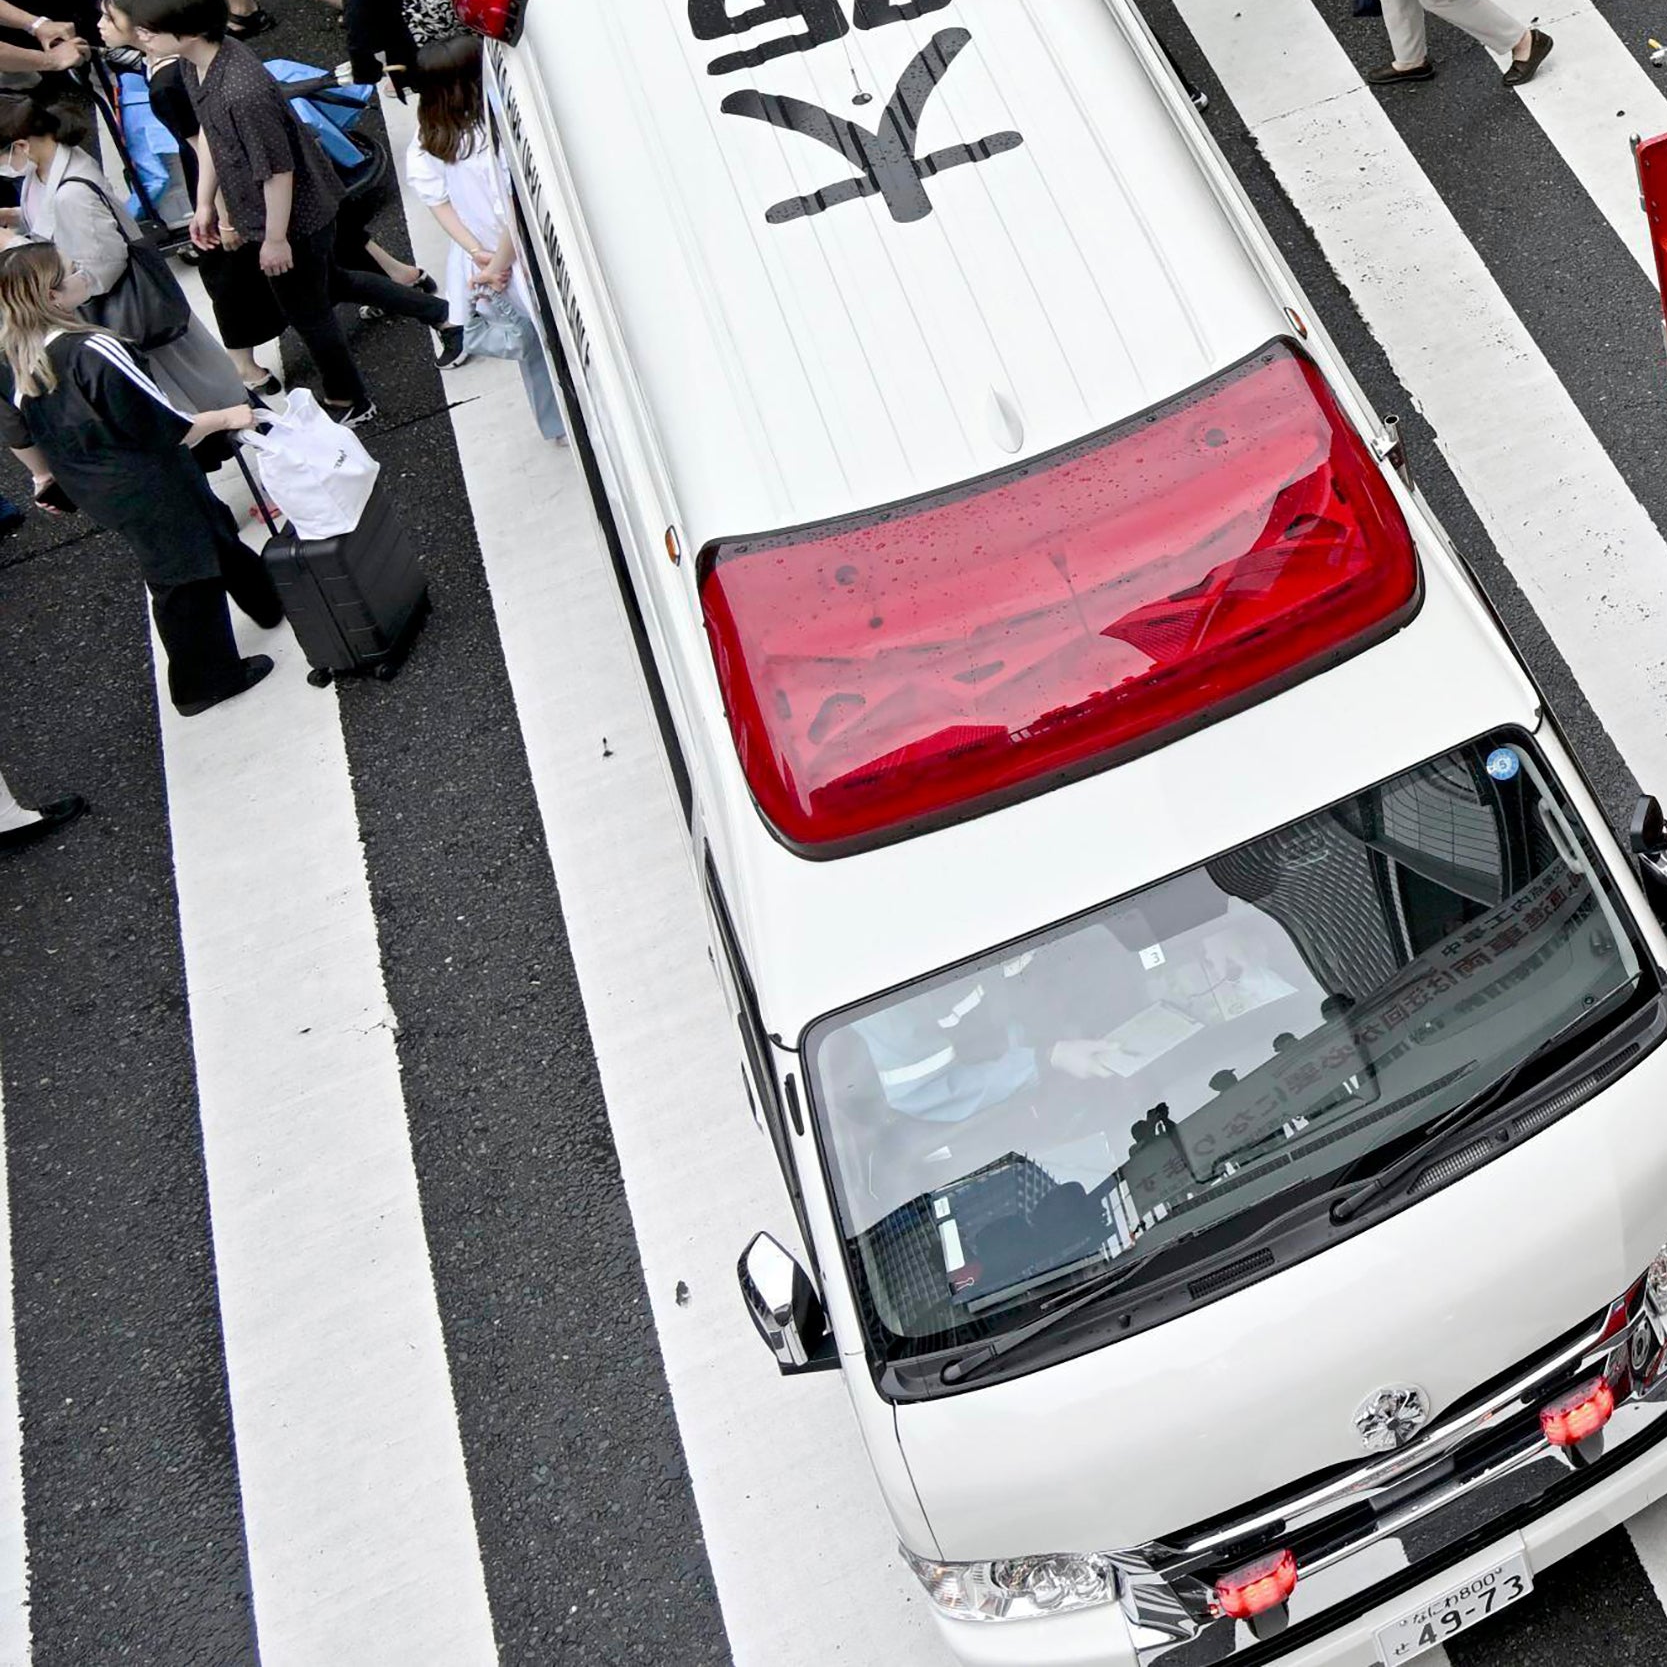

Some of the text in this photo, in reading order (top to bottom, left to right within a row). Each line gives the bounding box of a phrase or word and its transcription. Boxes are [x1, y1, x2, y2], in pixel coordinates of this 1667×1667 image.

[1152, 952, 1161, 964] 3
[1393, 1574, 1524, 1656] せ 49-73
[1412, 1572, 1496, 1625] なにわ800
